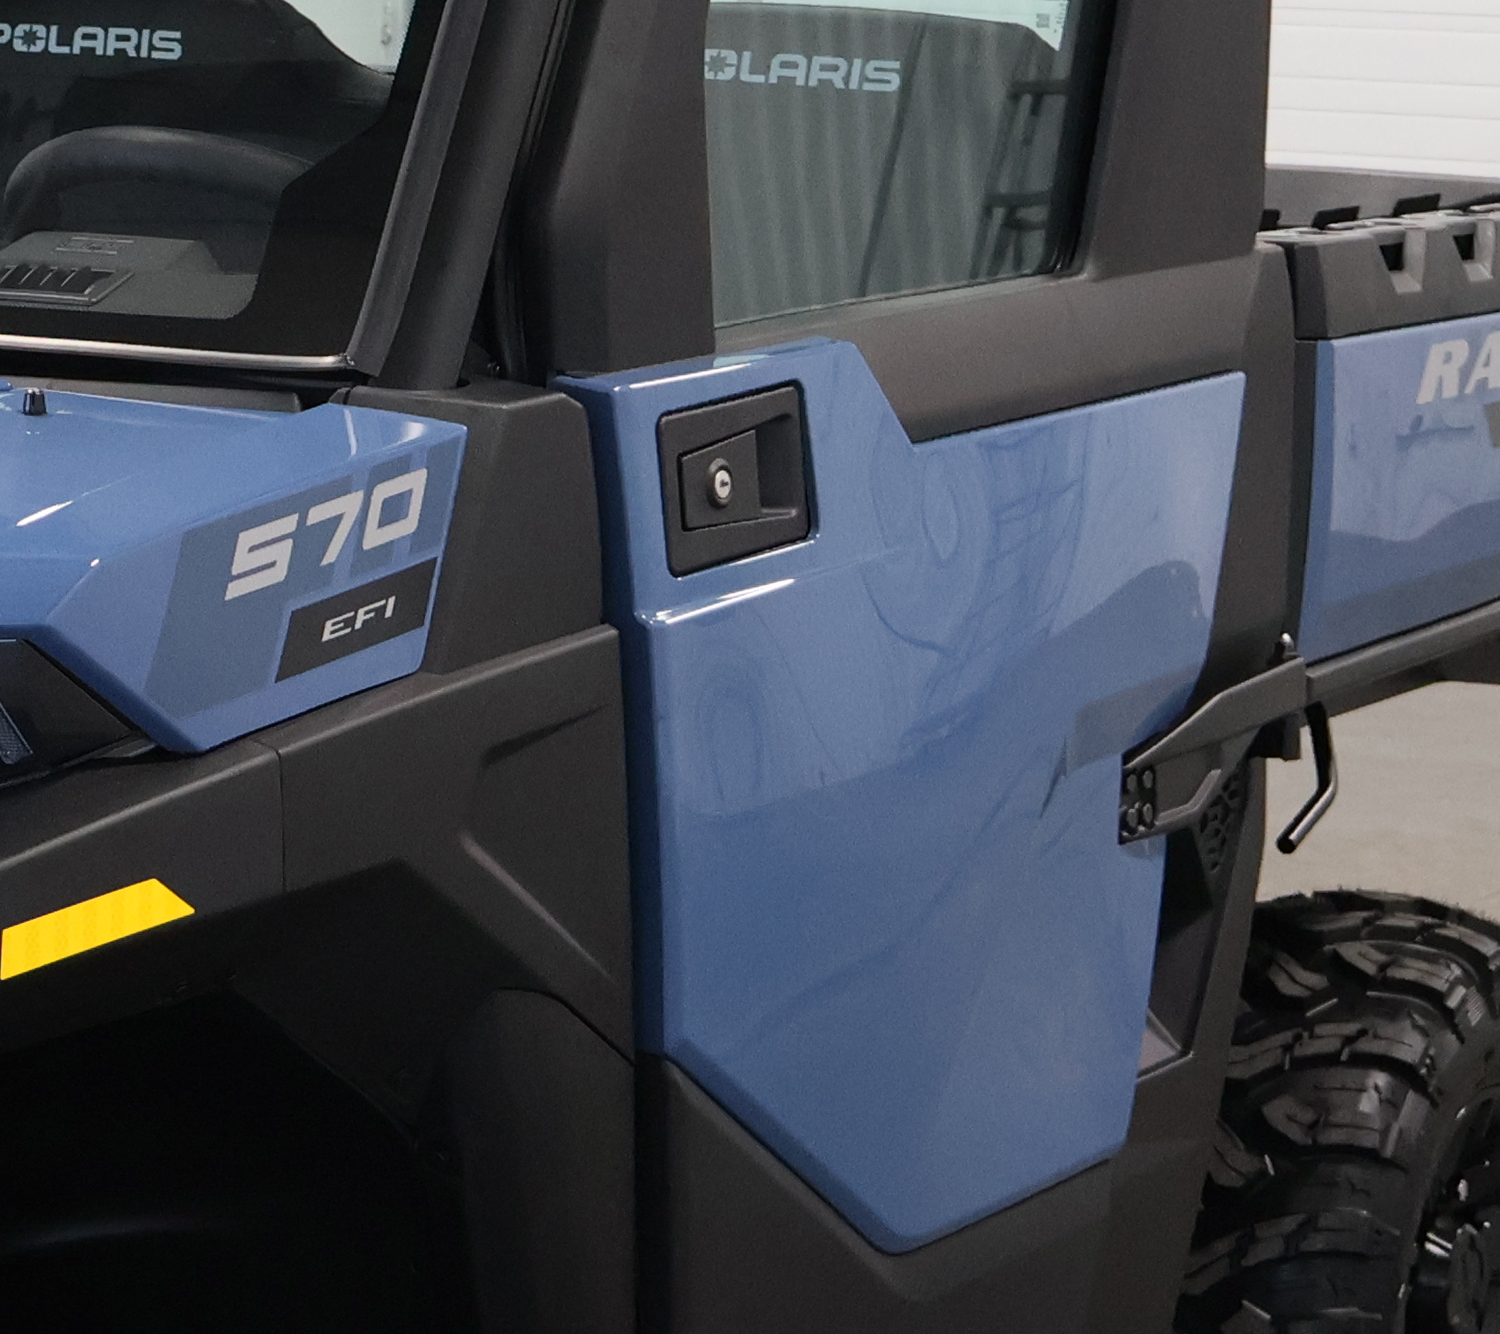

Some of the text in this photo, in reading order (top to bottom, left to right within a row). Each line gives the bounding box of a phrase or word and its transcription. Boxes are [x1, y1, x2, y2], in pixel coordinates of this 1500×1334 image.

[704, 48, 901, 92] OLARIS
[224, 468, 428, 601] 570
[321, 596, 396, 642] EFI
